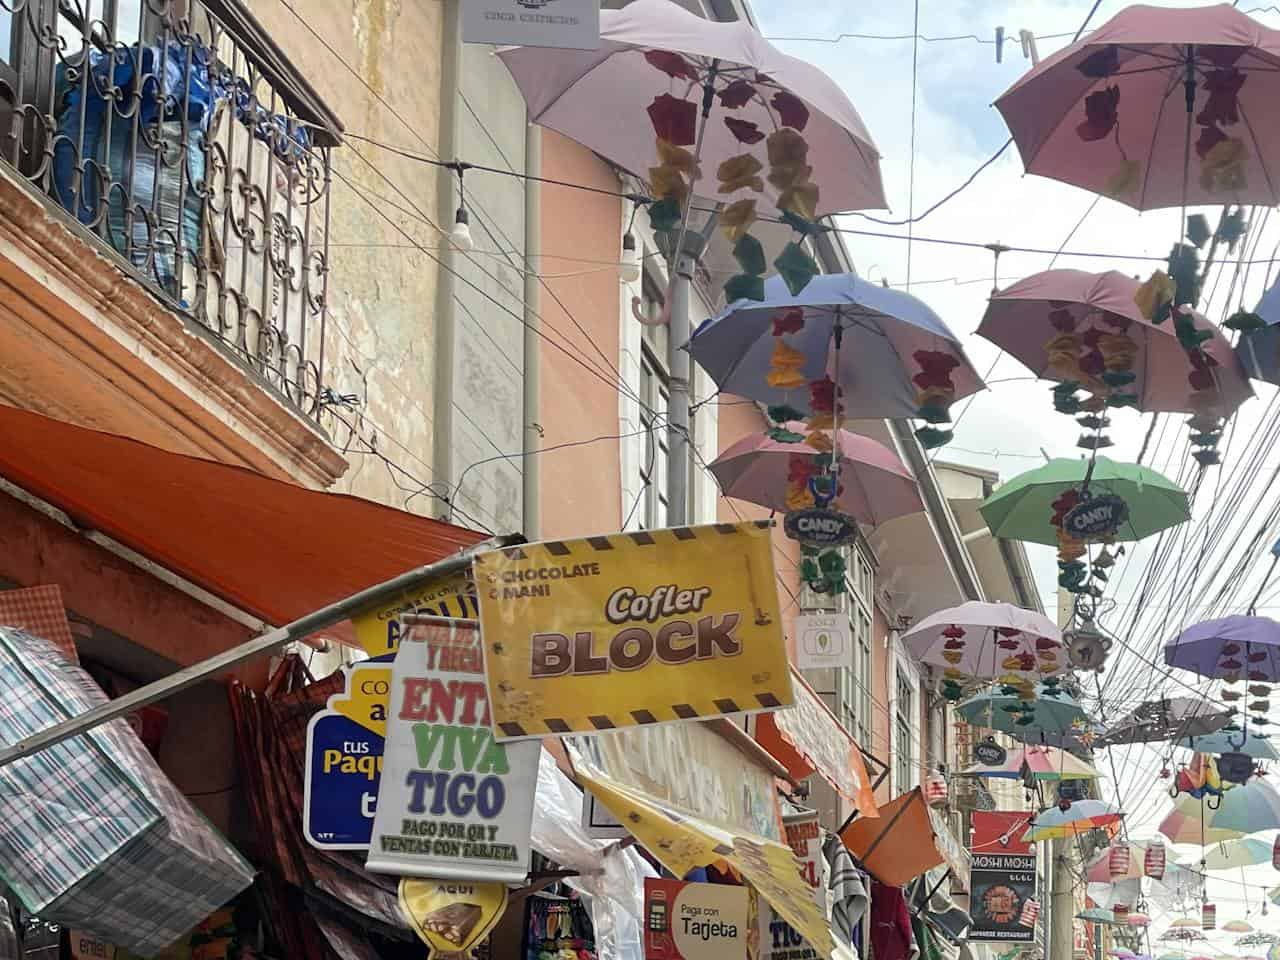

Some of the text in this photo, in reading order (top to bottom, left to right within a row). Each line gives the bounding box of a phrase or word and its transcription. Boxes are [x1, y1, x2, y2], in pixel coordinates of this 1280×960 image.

[798, 517, 844, 534] CANDY
[1074, 505, 1113, 529] CANDY
[503, 562, 600, 583] CHOCOLATE
[503, 584, 550, 600] MANI
[605, 585, 711, 624] Cofler
[529, 613, 743, 679] BLOCK
[344, 741, 370, 754] tus
[412, 723, 511, 775] VIVA
[405, 770, 506, 819] TIGO
[401, 820, 499, 842] PAGO POR QR Y
[381, 835, 519, 862] VENTAS CON TARJETA
[971, 857, 1036, 870] MOSHI MOSHI
[681, 903, 719, 917] Paga con
[681, 918, 737, 941] Tarjeta
